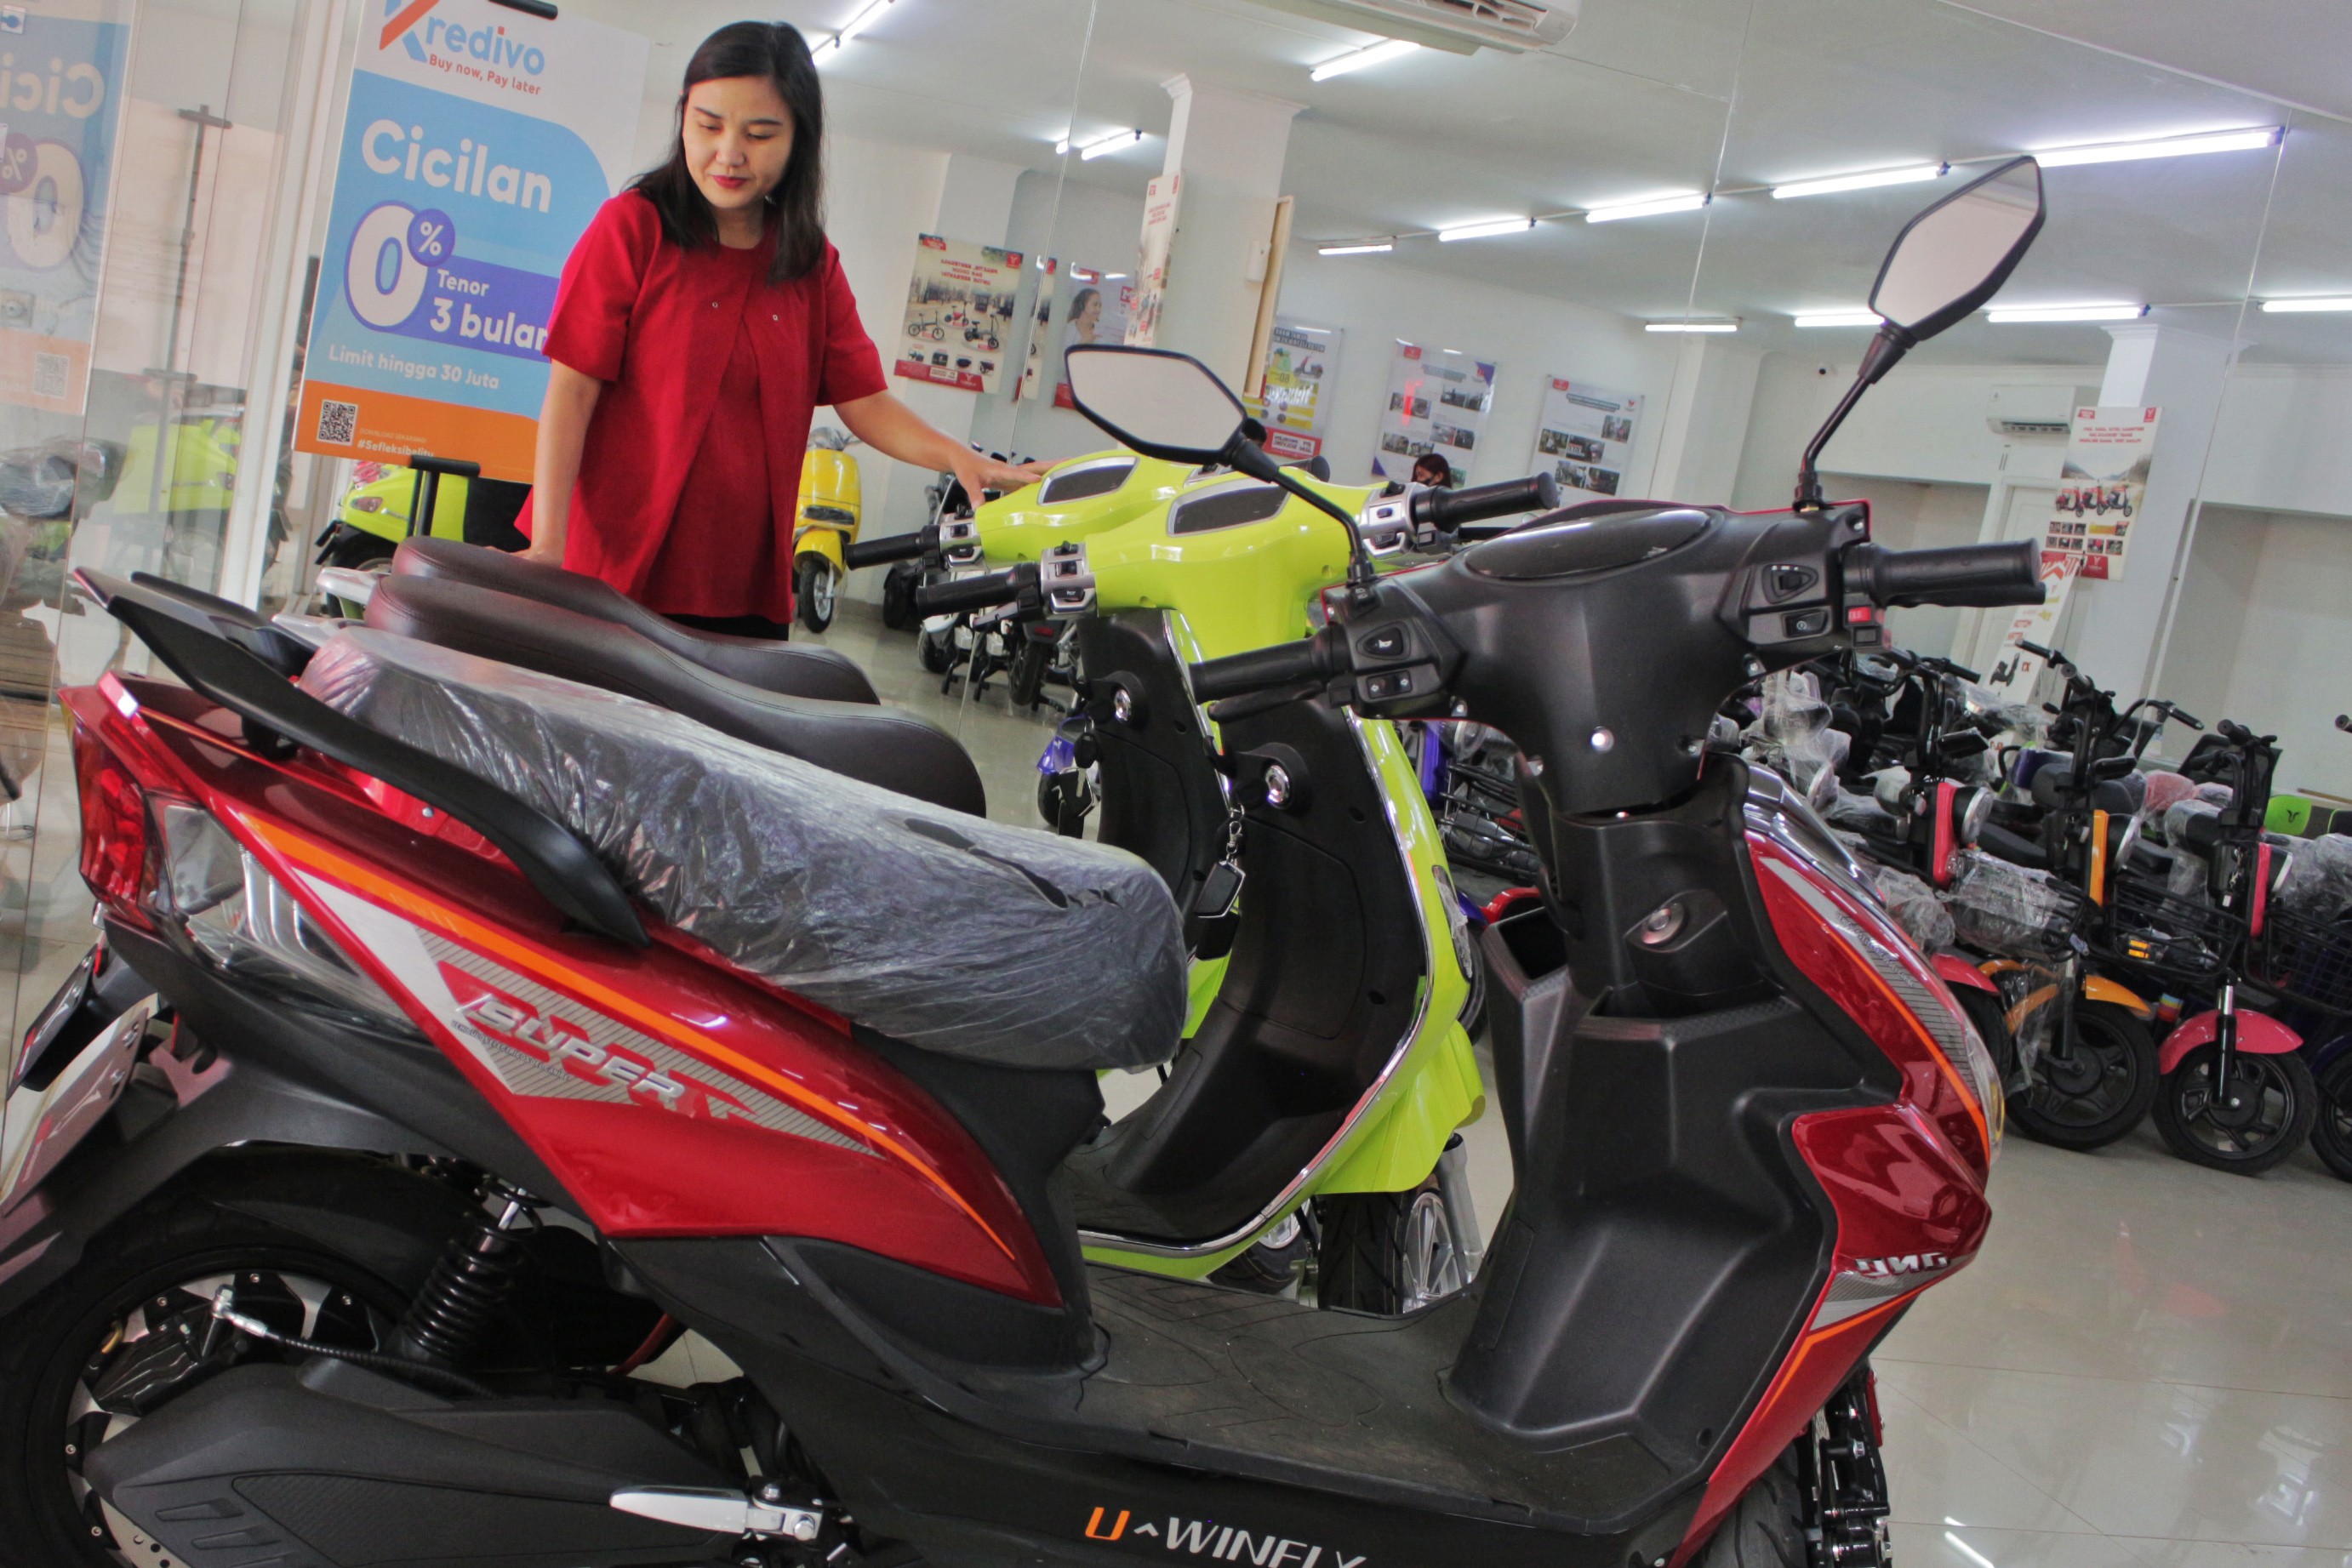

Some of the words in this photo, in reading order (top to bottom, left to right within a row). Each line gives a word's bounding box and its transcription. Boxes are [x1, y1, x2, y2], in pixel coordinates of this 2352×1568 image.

[380, 0, 545, 76] Kredivo
[430, 54, 453, 72] Buy
[456, 63, 484, 82] now,
[488, 71, 509, 88] Pay
[512, 76, 541, 95] later
[361, 118, 552, 214] Cicilan
[437, 269, 489, 297] Tenor
[430, 296, 453, 333] 3
[328, 344, 374, 367] Limit
[378, 349, 437, 382] hingga
[440, 363, 462, 383] 30
[465, 368, 500, 389] Juta
[471, 995, 686, 1109] SUPER
